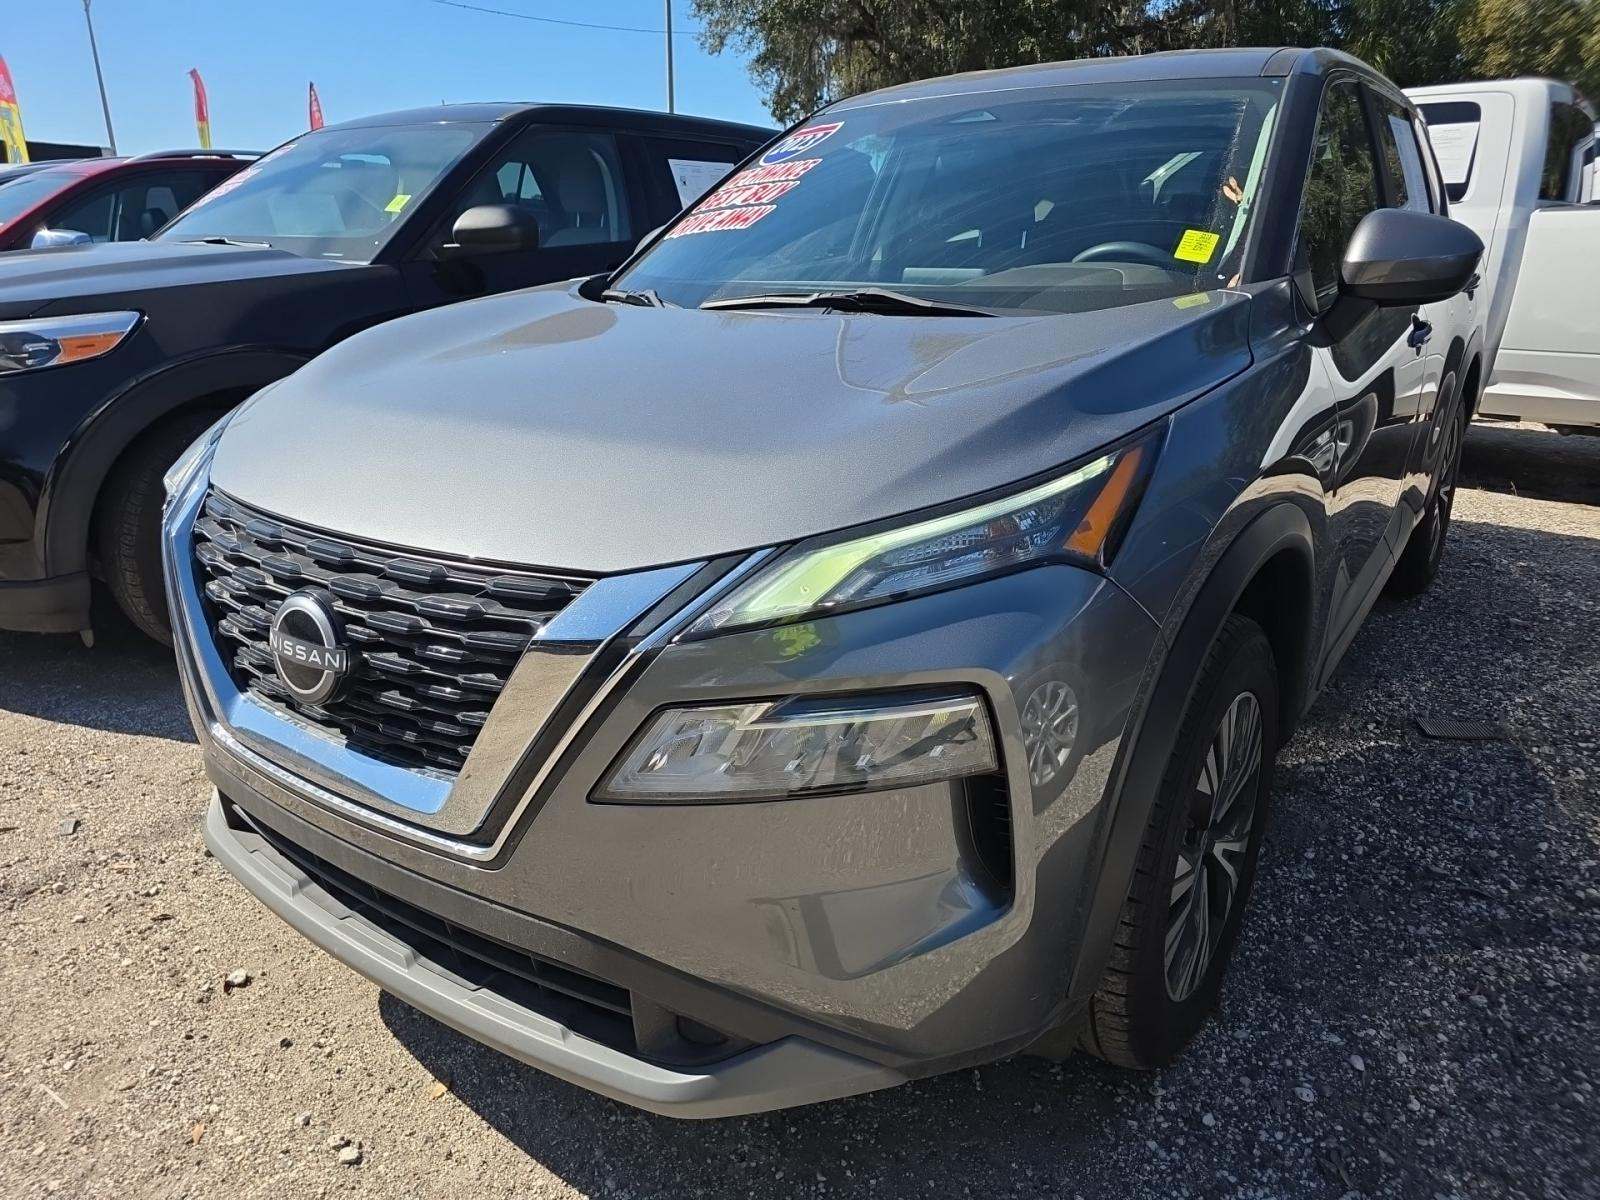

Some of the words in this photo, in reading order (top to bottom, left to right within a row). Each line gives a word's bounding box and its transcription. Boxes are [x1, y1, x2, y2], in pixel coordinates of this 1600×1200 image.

[696, 188, 753, 212] BEST
[741, 182, 798, 204] BUY
[269, 630, 340, 669] NISSAN
